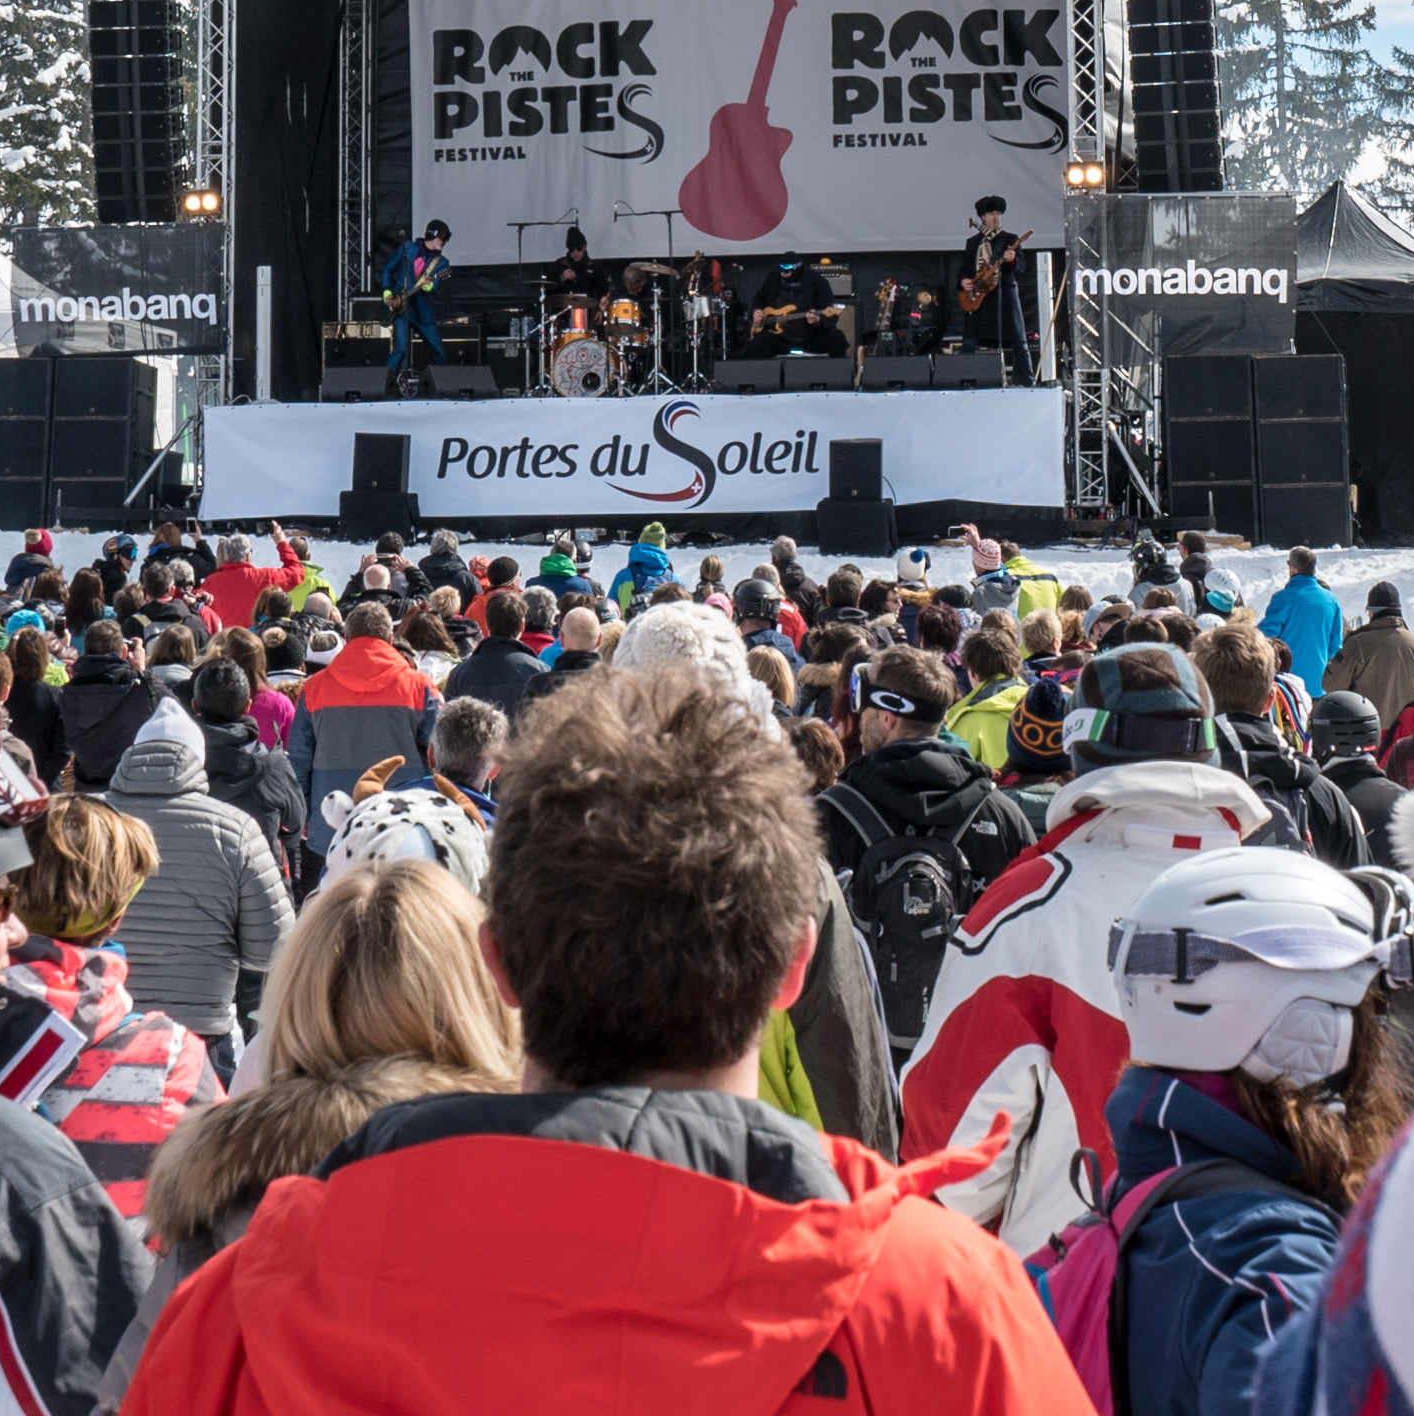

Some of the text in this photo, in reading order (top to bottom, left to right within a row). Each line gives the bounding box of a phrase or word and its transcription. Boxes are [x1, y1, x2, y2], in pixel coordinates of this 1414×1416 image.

[433, 19, 657, 85] ROCK
[831, 9, 1064, 69] ROCK
[509, 71, 535, 82] THE
[910, 57, 936, 67] THE
[433, 82, 665, 164] PISTES
[832, 72, 1069, 155] PISTES
[434, 146, 527, 163] FESTIVAL
[833, 133, 927, 148] FESTIVAL
[1075, 259, 1288, 304] monabanq
[19, 287, 218, 326] monabanq
[436, 399, 820, 510] Portes du Soleil
